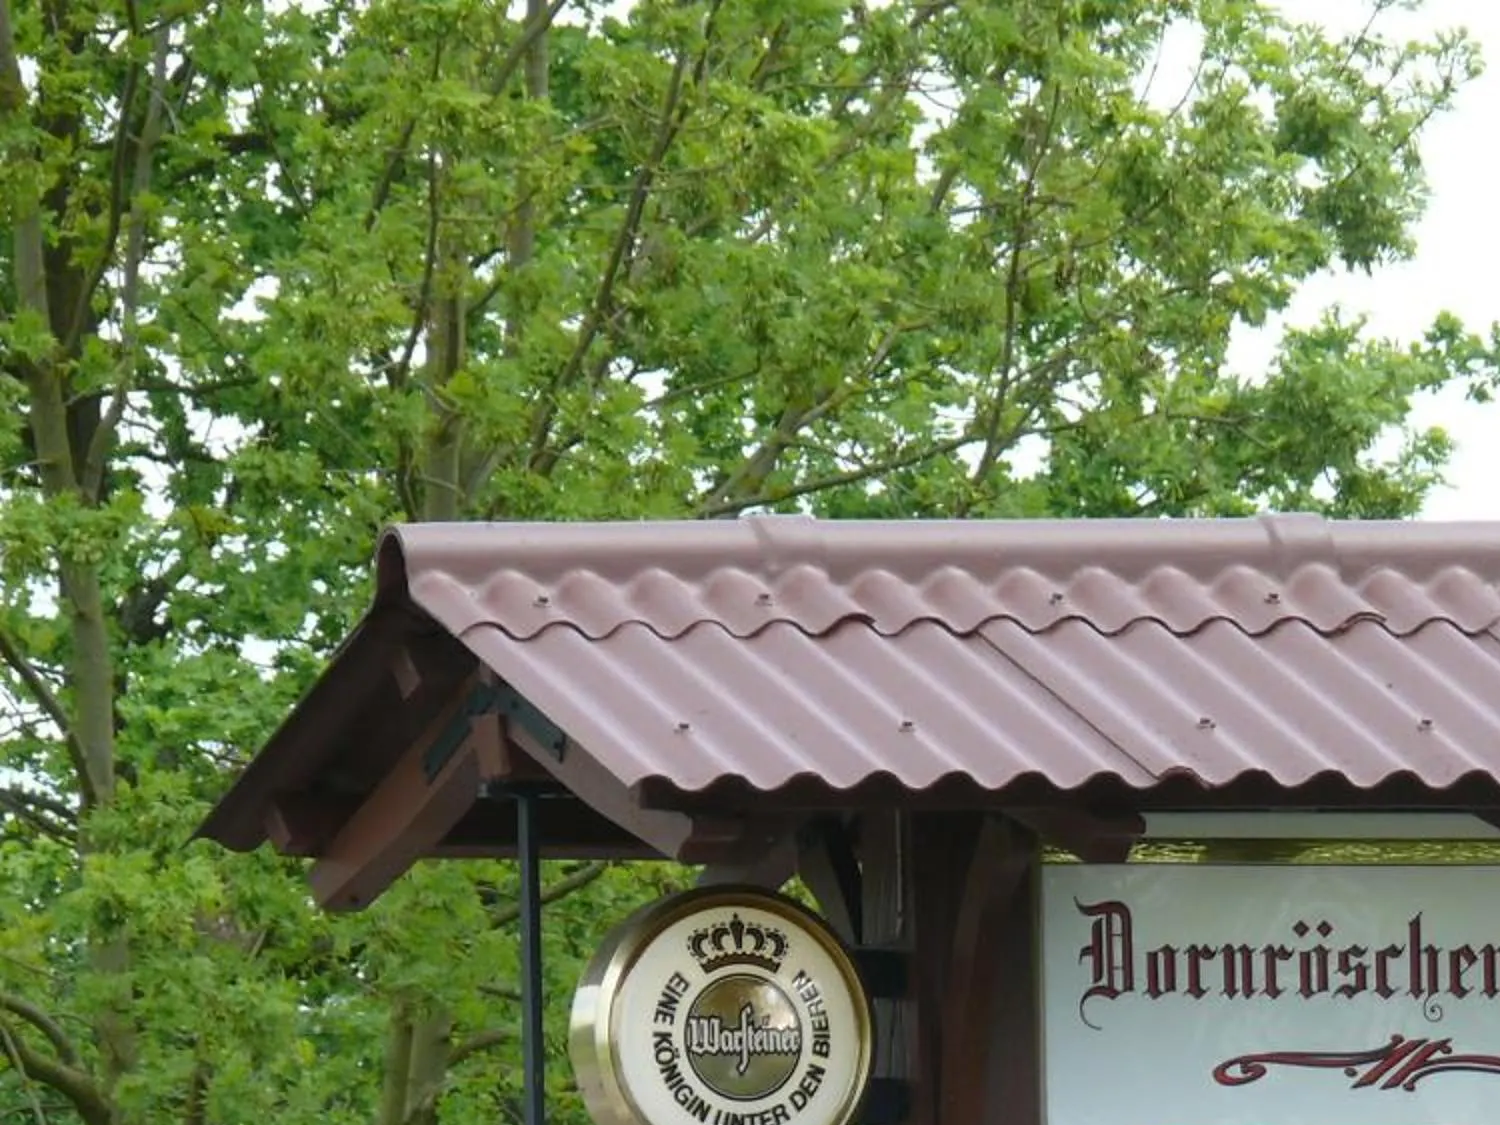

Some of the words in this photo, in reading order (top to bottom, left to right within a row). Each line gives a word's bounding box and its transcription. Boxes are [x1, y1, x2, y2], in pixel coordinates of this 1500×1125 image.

[653, 970, 690, 1027] EINE
[791, 969, 831, 1059] BIEREN
[652, 1031, 713, 1123] KÖNIGIN
[788, 1063, 826, 1113] DEN
